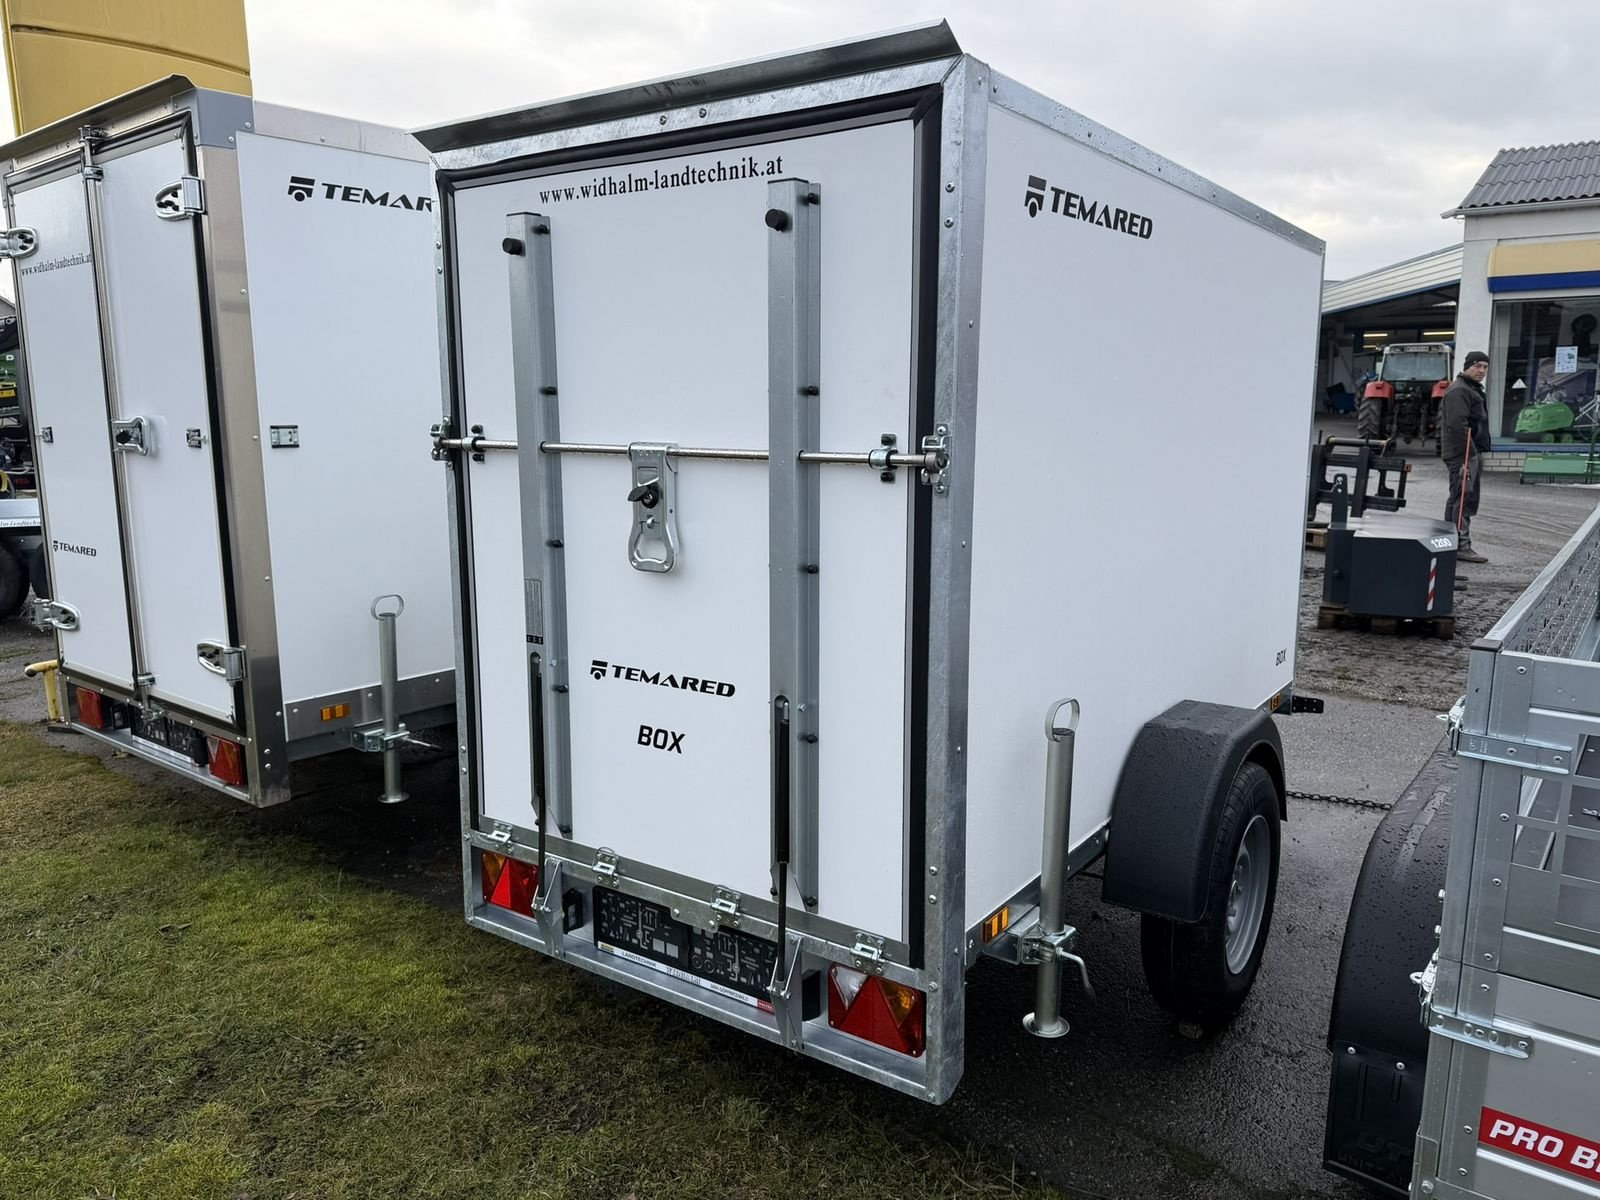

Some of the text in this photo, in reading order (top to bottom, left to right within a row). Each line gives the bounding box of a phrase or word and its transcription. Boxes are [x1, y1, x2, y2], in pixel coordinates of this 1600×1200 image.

[539, 155, 783, 204] www.widhalm-landtechnik.at
[1050, 186, 1153, 240] TEMARED
[59, 542, 97, 557] TEMARED
[1431, 537, 1453, 549] 1200
[1275, 647, 1288, 667] BOX
[612, 664, 736, 698] TEMARED
[637, 724, 686, 754] BOX
[1489, 1118, 1600, 1174] PRO B
